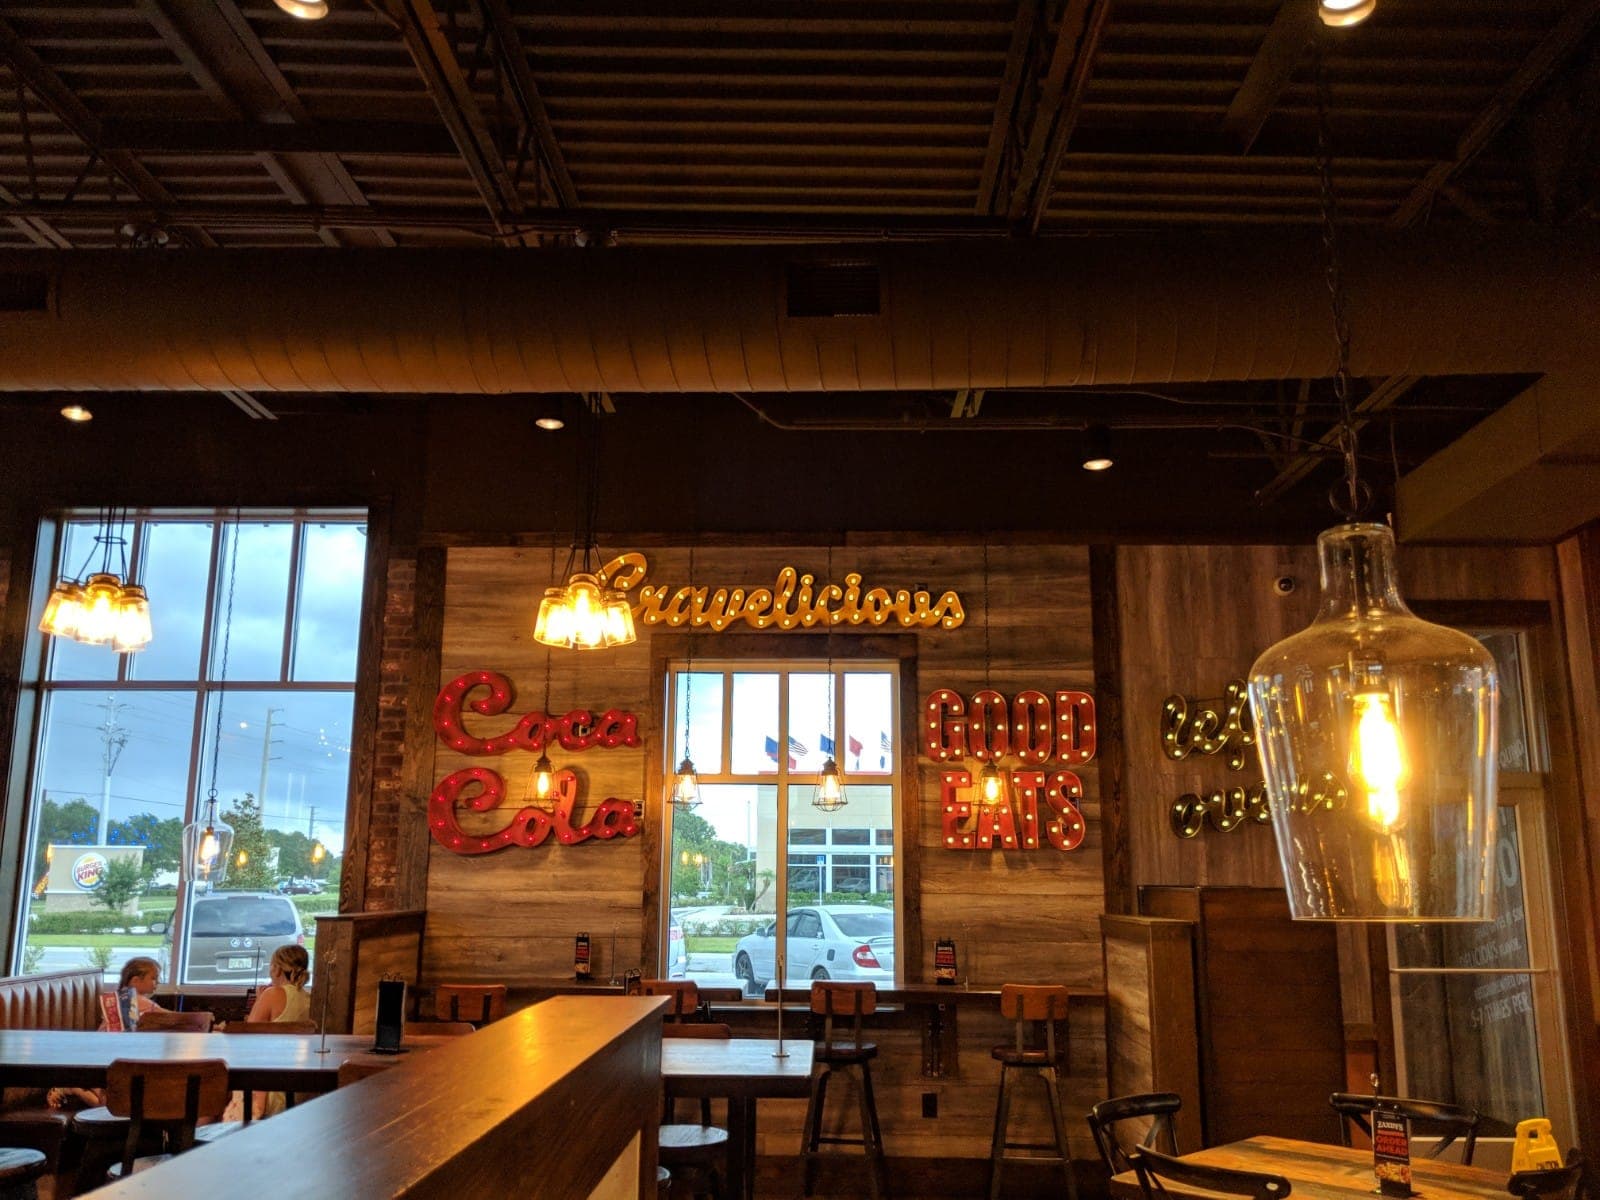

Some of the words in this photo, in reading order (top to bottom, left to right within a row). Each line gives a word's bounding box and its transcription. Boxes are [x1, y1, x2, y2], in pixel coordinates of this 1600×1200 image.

[433, 671, 643, 757] Coca
[926, 689, 1097, 765] GOOD
[428, 767, 641, 855] Cola
[940, 770, 1086, 850] EATS
[77, 867, 105, 882] KING
